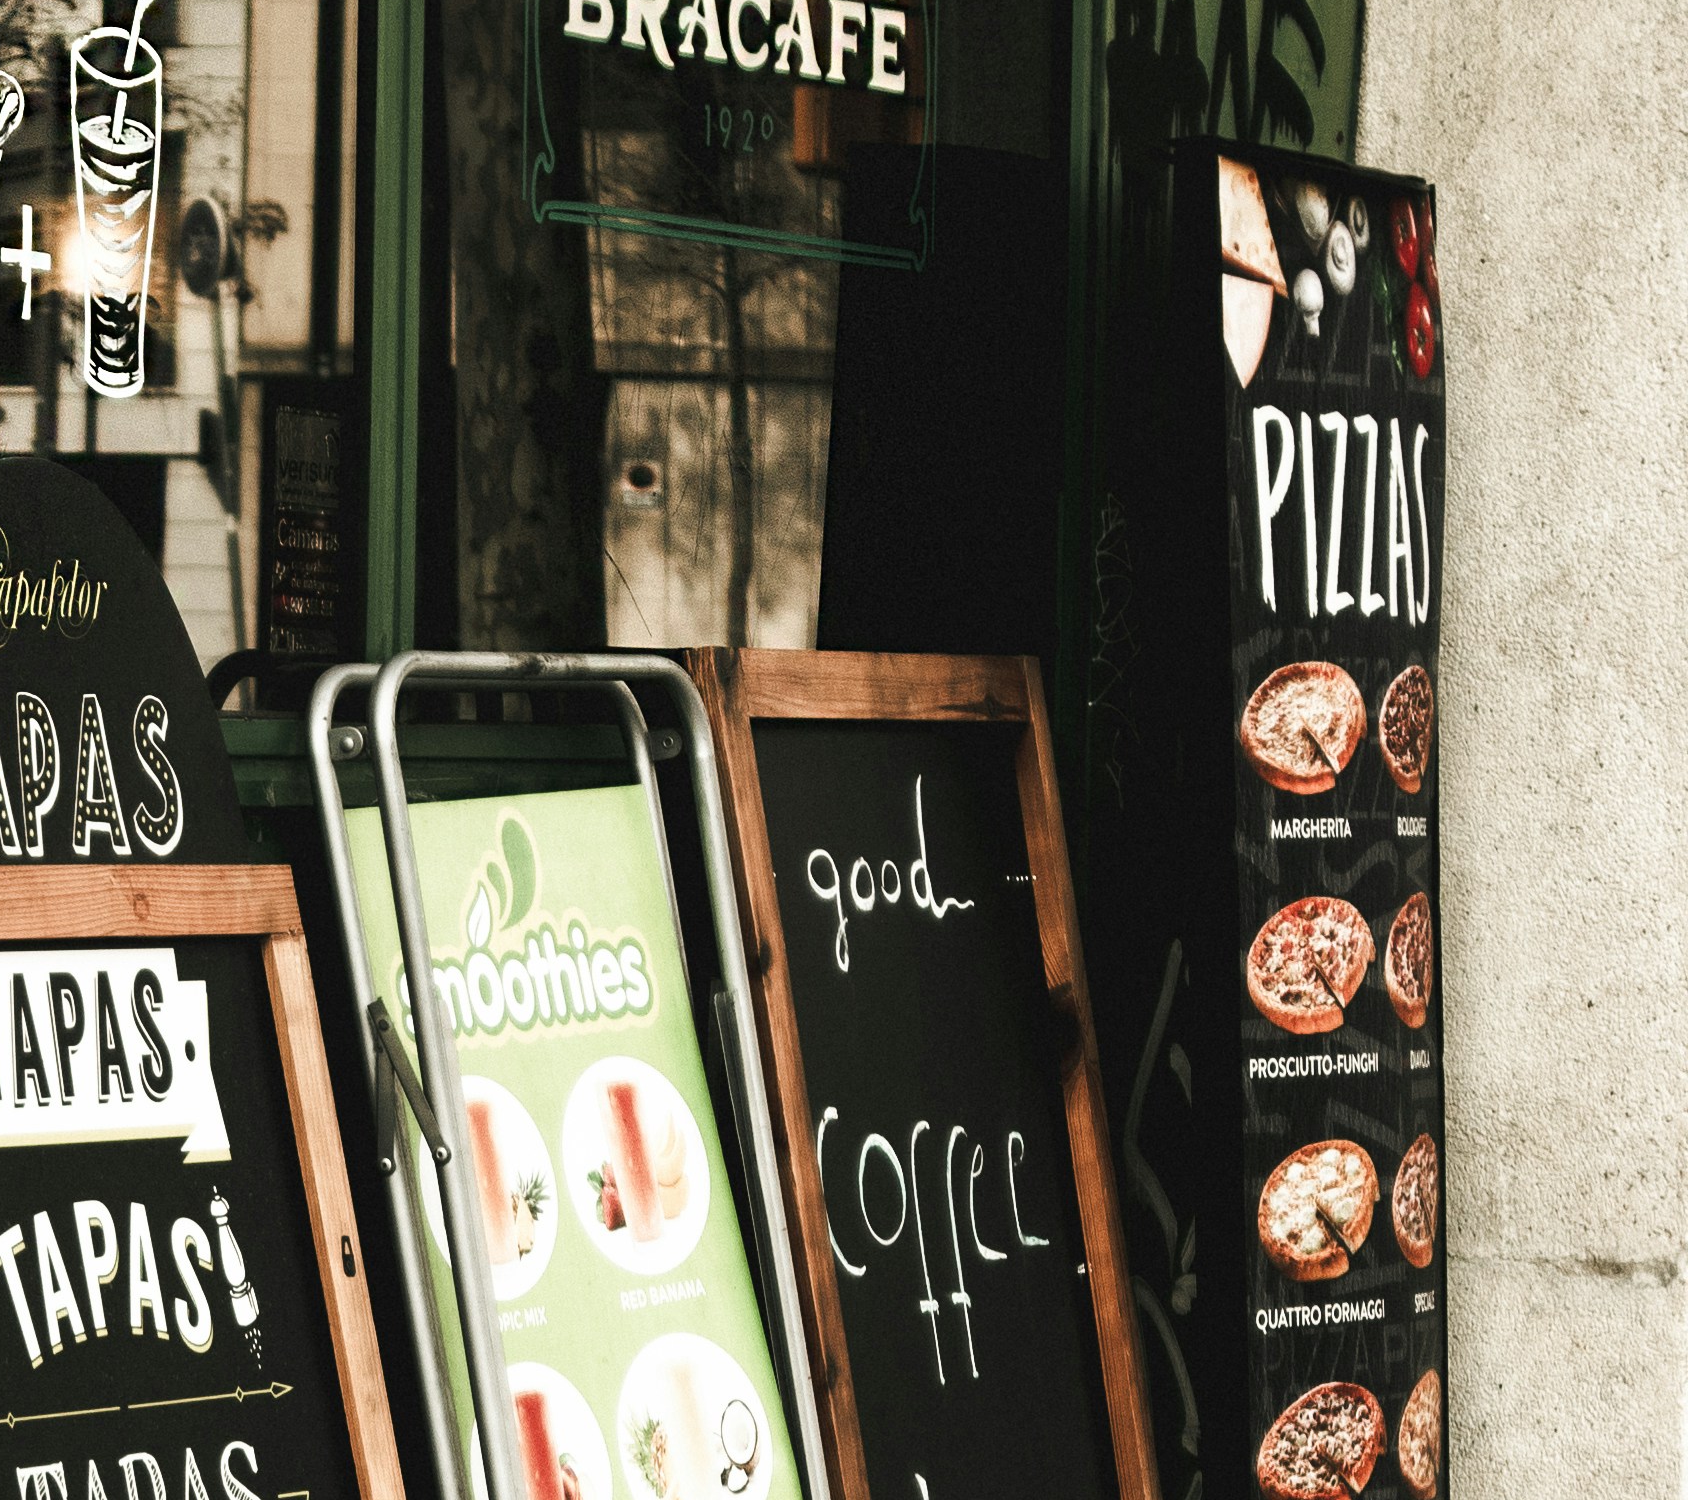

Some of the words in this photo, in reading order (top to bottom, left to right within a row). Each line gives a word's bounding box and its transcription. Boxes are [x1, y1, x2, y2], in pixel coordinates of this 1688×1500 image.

[705, 104, 774, 152] 1920
[1252, 404, 1430, 628] PIZZAS
[1271, 817, 1352, 839] MARGHERITA
[807, 775, 975, 972] good
[400, 918, 654, 1035] moothies
[1249, 1052, 1379, 1079] PROSCIUTTO-FUNGHI
[621, 1285, 648, 1311] RED
[650, 1278, 707, 1306] BANANA
[1256, 1304, 1321, 1334] QUATTRO
[1324, 1298, 1385, 1324] FORMAGGI
